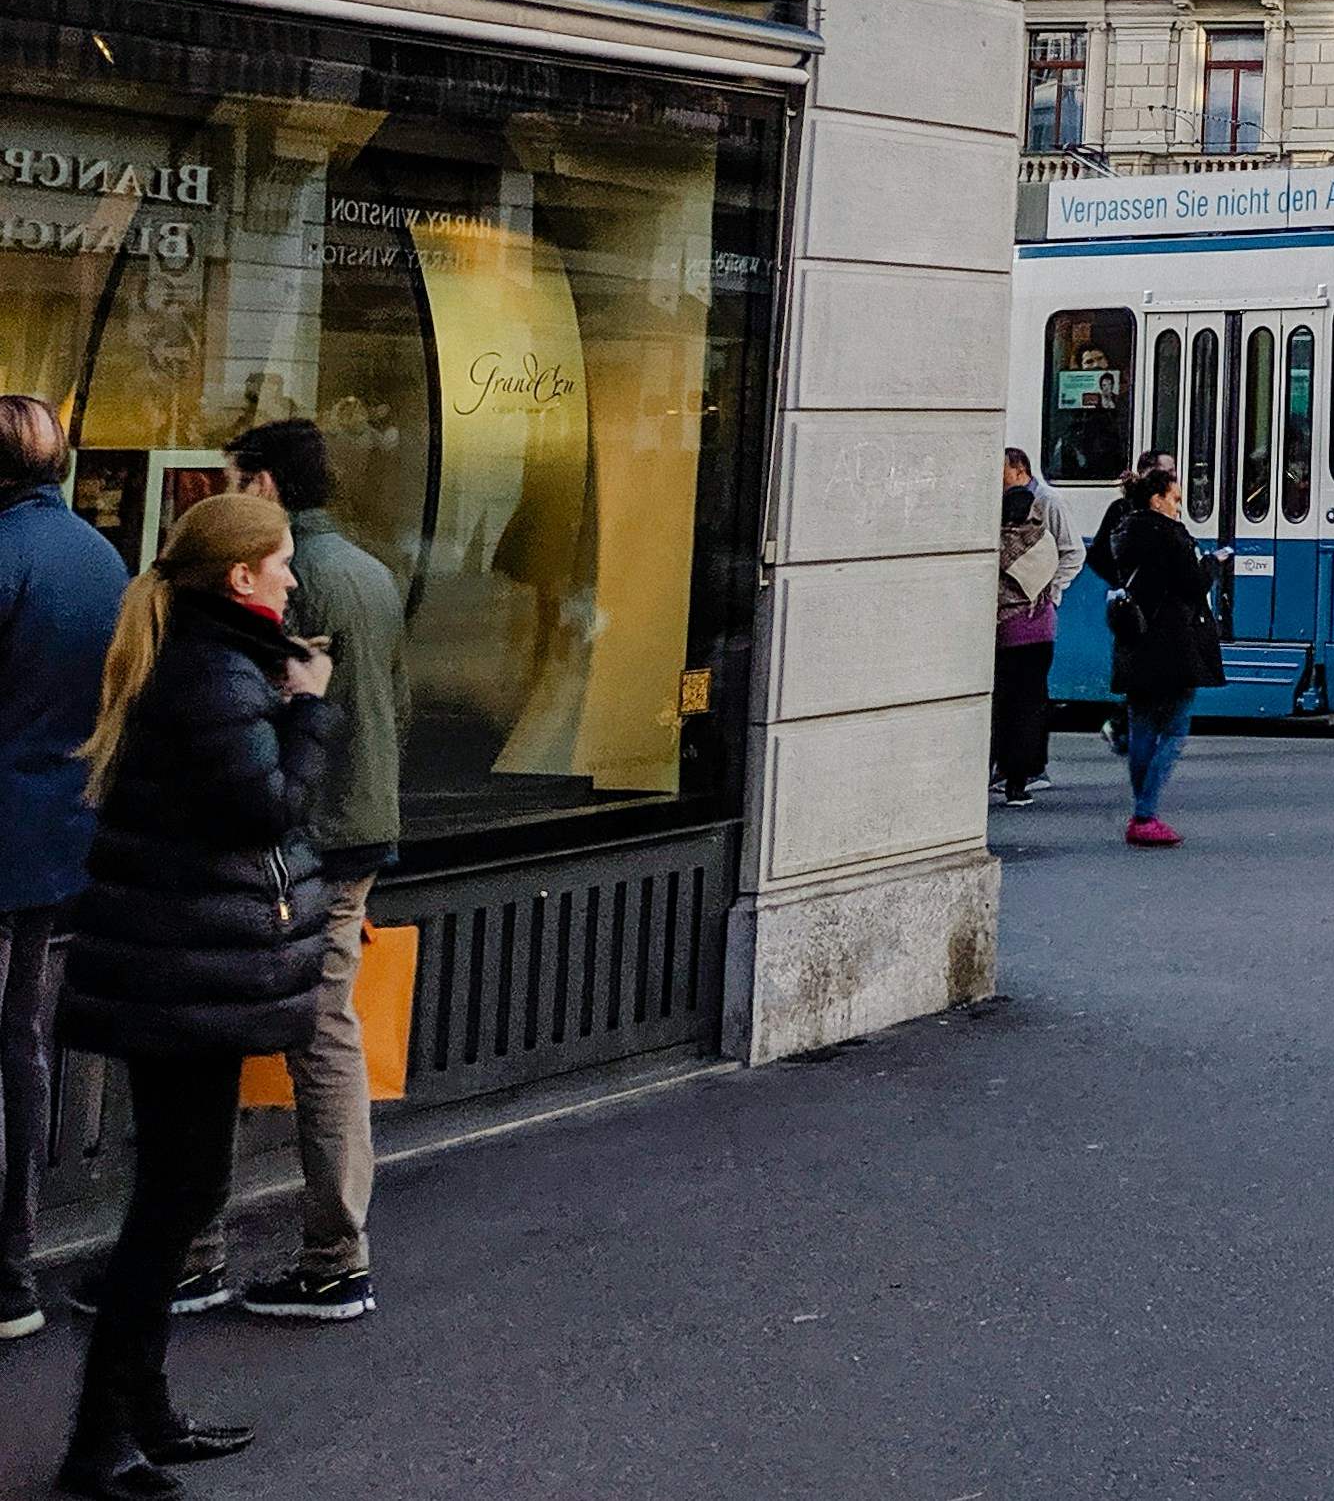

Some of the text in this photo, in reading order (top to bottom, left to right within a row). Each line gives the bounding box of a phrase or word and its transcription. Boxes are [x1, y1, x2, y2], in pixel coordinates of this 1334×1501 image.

[1061, 194, 1167, 227] Verpassen
[1176, 189, 1208, 218] Sie
[1216, 186, 1270, 216] nicht
[1277, 179, 1318, 213] den
[453, 352, 540, 415] Grand
